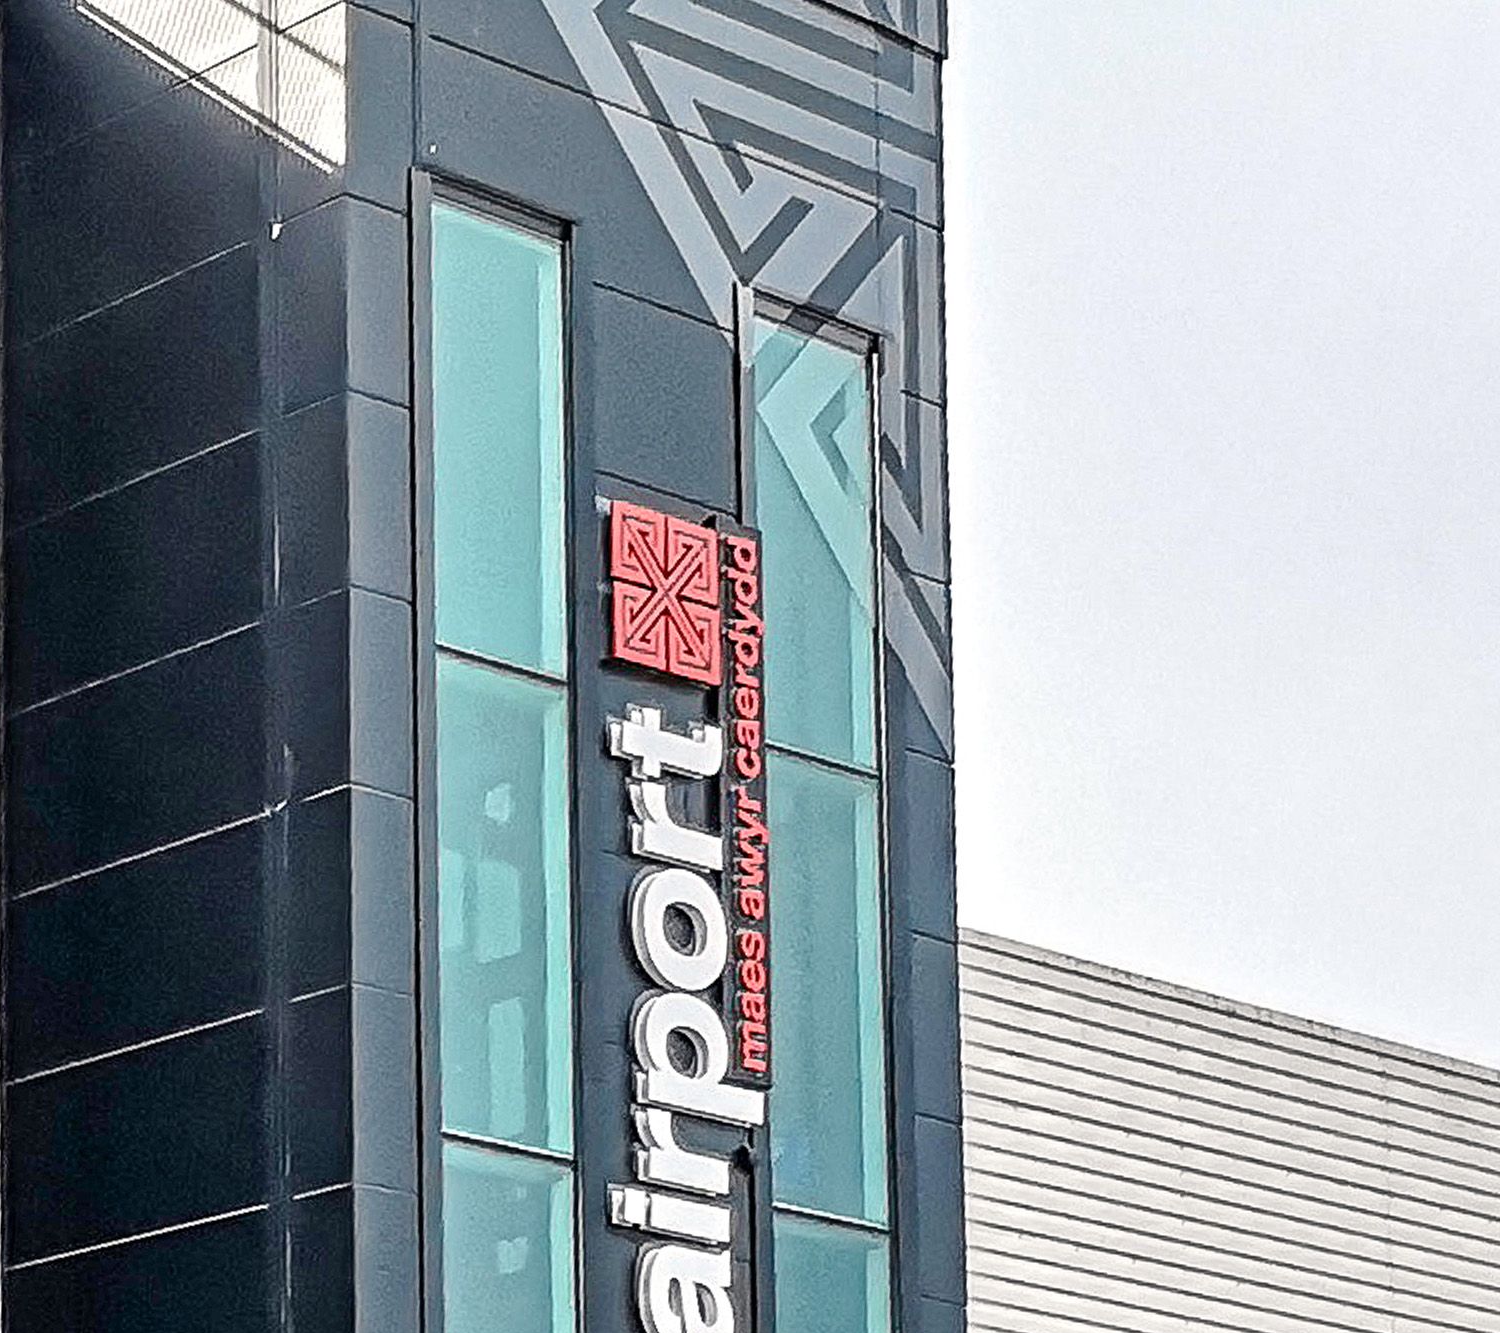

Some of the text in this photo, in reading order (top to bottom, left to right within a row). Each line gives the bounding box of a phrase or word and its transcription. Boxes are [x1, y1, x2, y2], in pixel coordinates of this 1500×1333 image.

[722, 536, 771, 1073] maes awyr caerdydd
